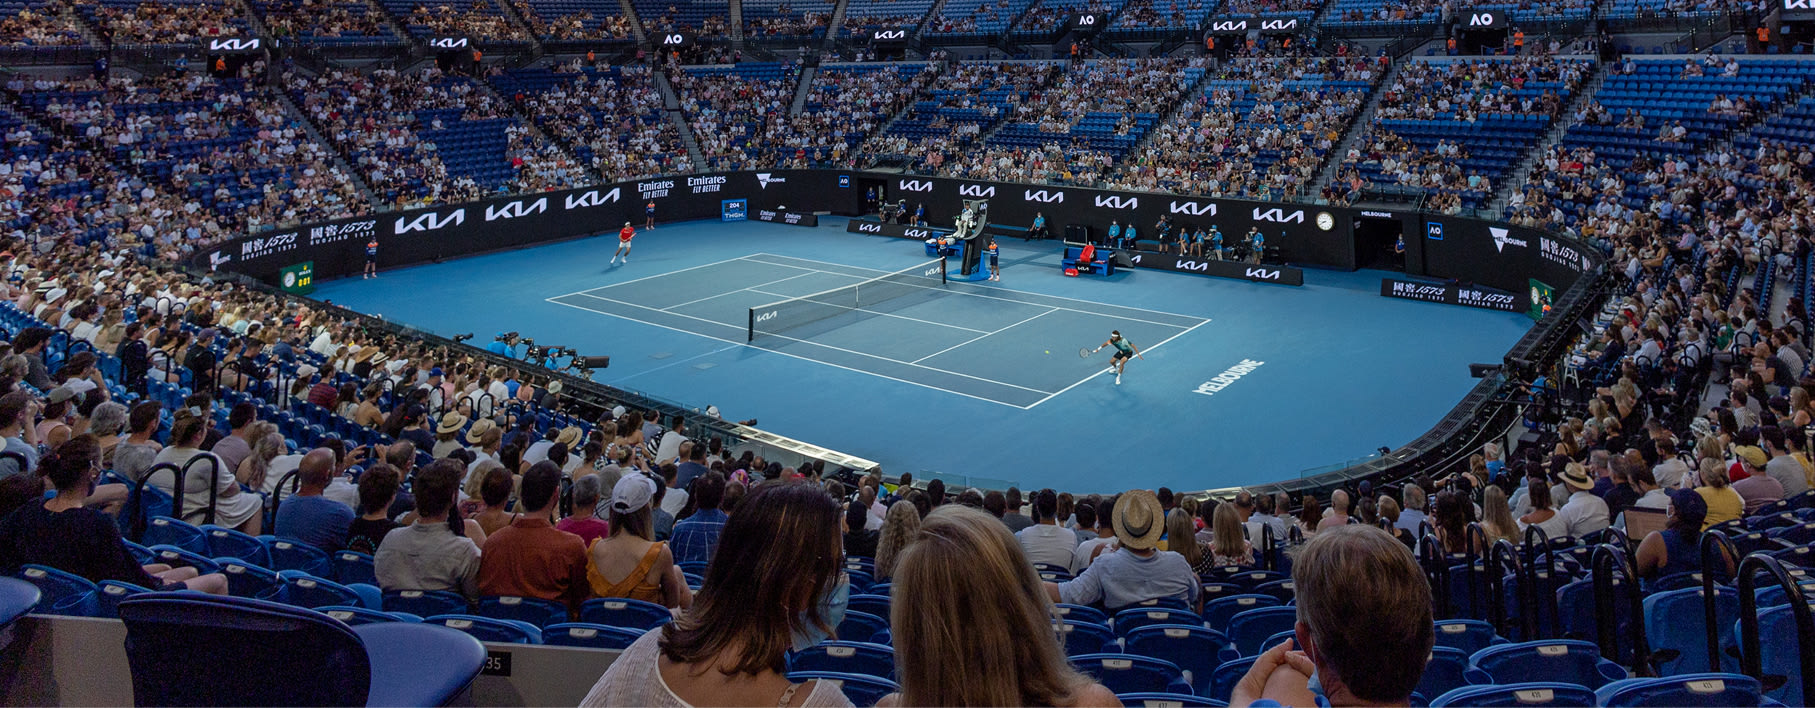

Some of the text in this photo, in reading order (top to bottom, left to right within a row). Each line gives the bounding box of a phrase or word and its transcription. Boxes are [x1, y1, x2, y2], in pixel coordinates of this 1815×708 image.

[1080, 15, 1094, 25] AO
[1470, 14, 1492, 25] AO
[664, 35, 682, 44] AO
[638, 180, 674, 192] Emirates
[688, 176, 727, 187] Emirates
[651, 189, 669, 198] BETTER
[702, 184, 721, 193] BETTER
[1429, 227, 1441, 235] AO
[1191, 358, 1265, 396] MELBOURNE
